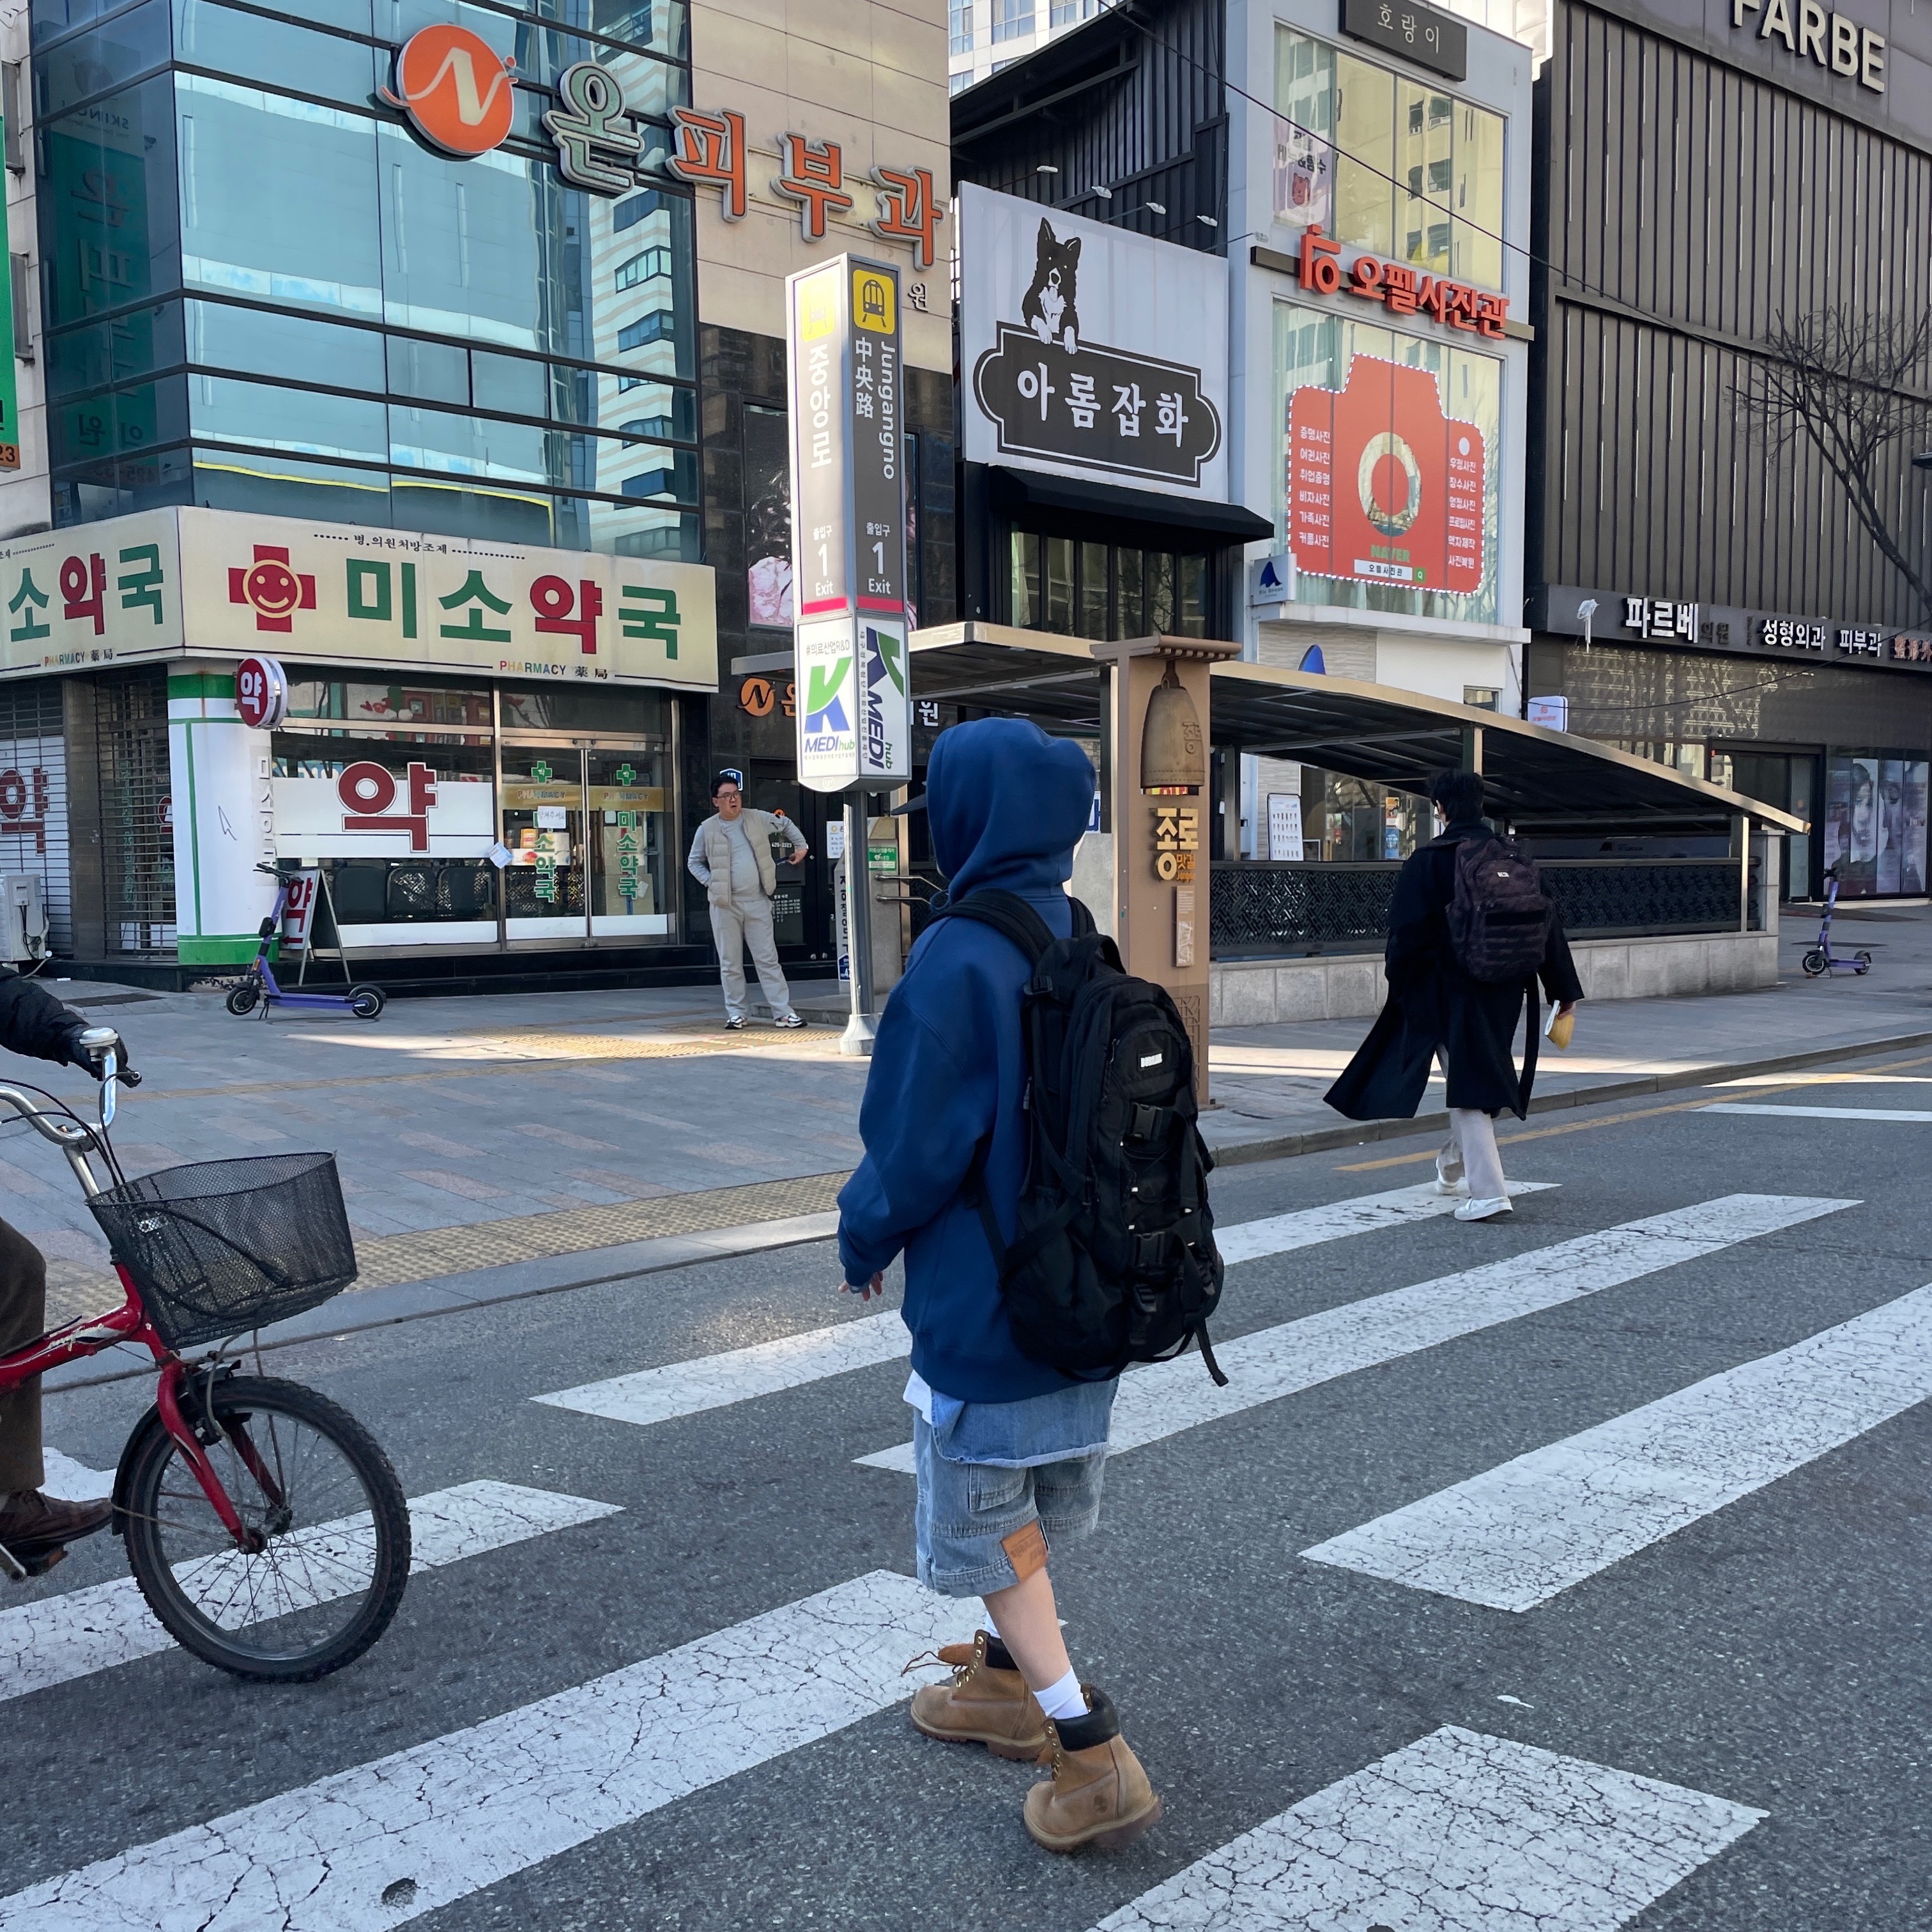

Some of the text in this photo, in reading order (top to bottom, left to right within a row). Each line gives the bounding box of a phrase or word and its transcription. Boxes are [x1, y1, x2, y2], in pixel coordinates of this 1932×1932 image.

[1377, 3, 1440, 54] 호랑이
[1349, 256, 1510, 341] 오펠사진관
[855, 336, 874, 420] 中央路
[808, 343, 832, 469] 중앙로
[878, 340, 896, 480] Jungangno
[1016, 362, 1190, 448] 아롬잡화
[1300, 425, 1330, 444] 증명사진
[1300, 447, 1330, 464] 여권사진
[1450, 457, 1476, 473] 우정사진
[1299, 468, 1330, 486] 취업증명
[1449, 477, 1476, 493] 장수사진
[1299, 490, 1330, 506] 비자사진
[1299, 510, 1330, 527] 가족사진
[813, 525, 832, 542] 출입구
[866, 521, 891, 538] 출입구
[1298, 532, 1330, 548] 커플사진
[817, 542, 828, 577] 1
[871, 541, 884, 575] 1
[1370, 544, 1411, 563] NAVER
[8, 543, 164, 642] 소약국
[815, 581, 834, 597] Exit
[868, 578, 891, 595] Exit
[346, 558, 682, 661] 미소약국
[1625, 597, 1699, 644] 파르베
[1762, 618, 1826, 650] 성형외과
[1839, 629, 1882, 658] 피부과
[806, 639, 850, 656] #의료산업R&D
[44, 652, 85, 667] PHARMACY
[500, 660, 566, 676] PHARMACY
[241, 671, 263, 714] 약
[868, 689, 885, 770] MEDI
[804, 735, 855, 753] MEDI hub
[517, 790, 566, 799] PHARMACY
[604, 792, 649, 801] PHARMACY
[336, 760, 438, 854] 약
[1156, 808, 1199, 880] 종로
[617, 810, 640, 900] 미소약국
[1176, 853, 1196, 870] 맛길
[286, 877, 313, 933] 약
